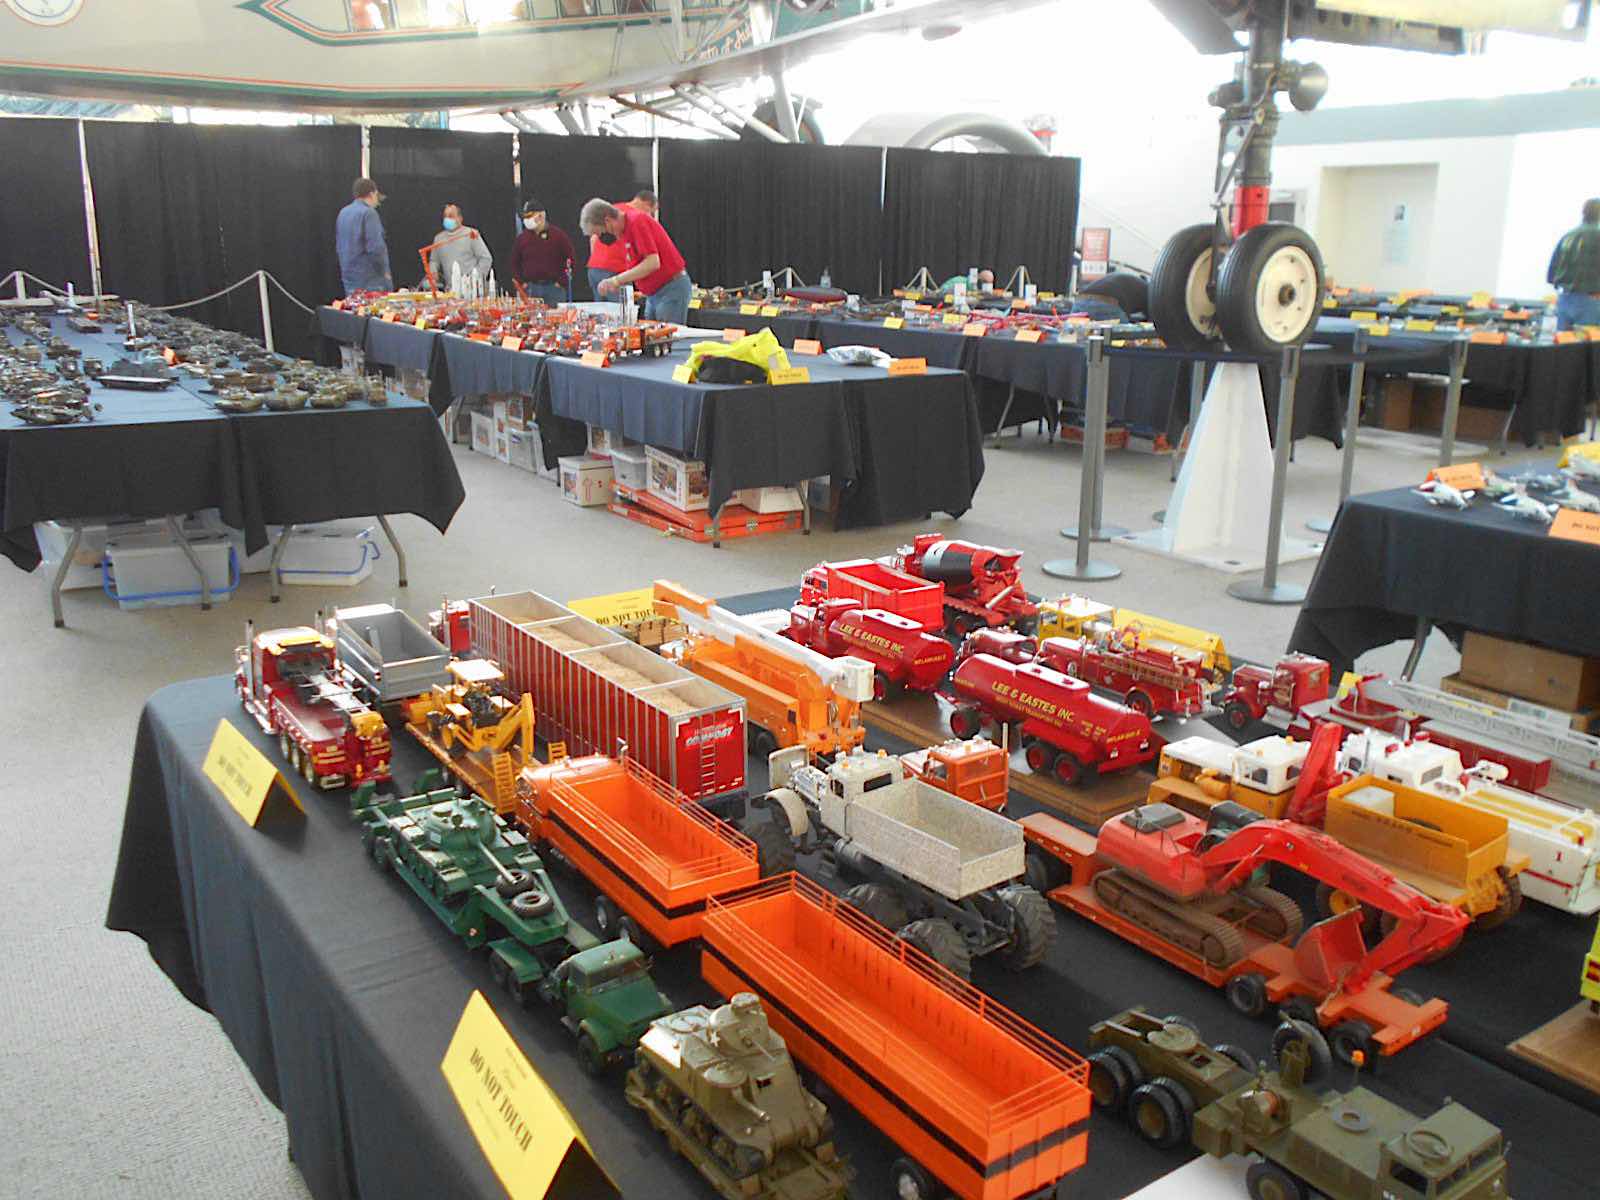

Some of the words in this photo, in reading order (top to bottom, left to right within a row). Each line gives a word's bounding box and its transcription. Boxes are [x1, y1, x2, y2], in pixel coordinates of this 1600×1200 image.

[861, 631, 890, 649] EASTES
[991, 680, 1008, 696] LEE
[1019, 691, 1057, 714] EASTES
[1057, 707, 1075, 723] INC
[470, 1048, 485, 1072] DO
[482, 1068, 502, 1101] NOT
[499, 1098, 533, 1152] TOUCH
